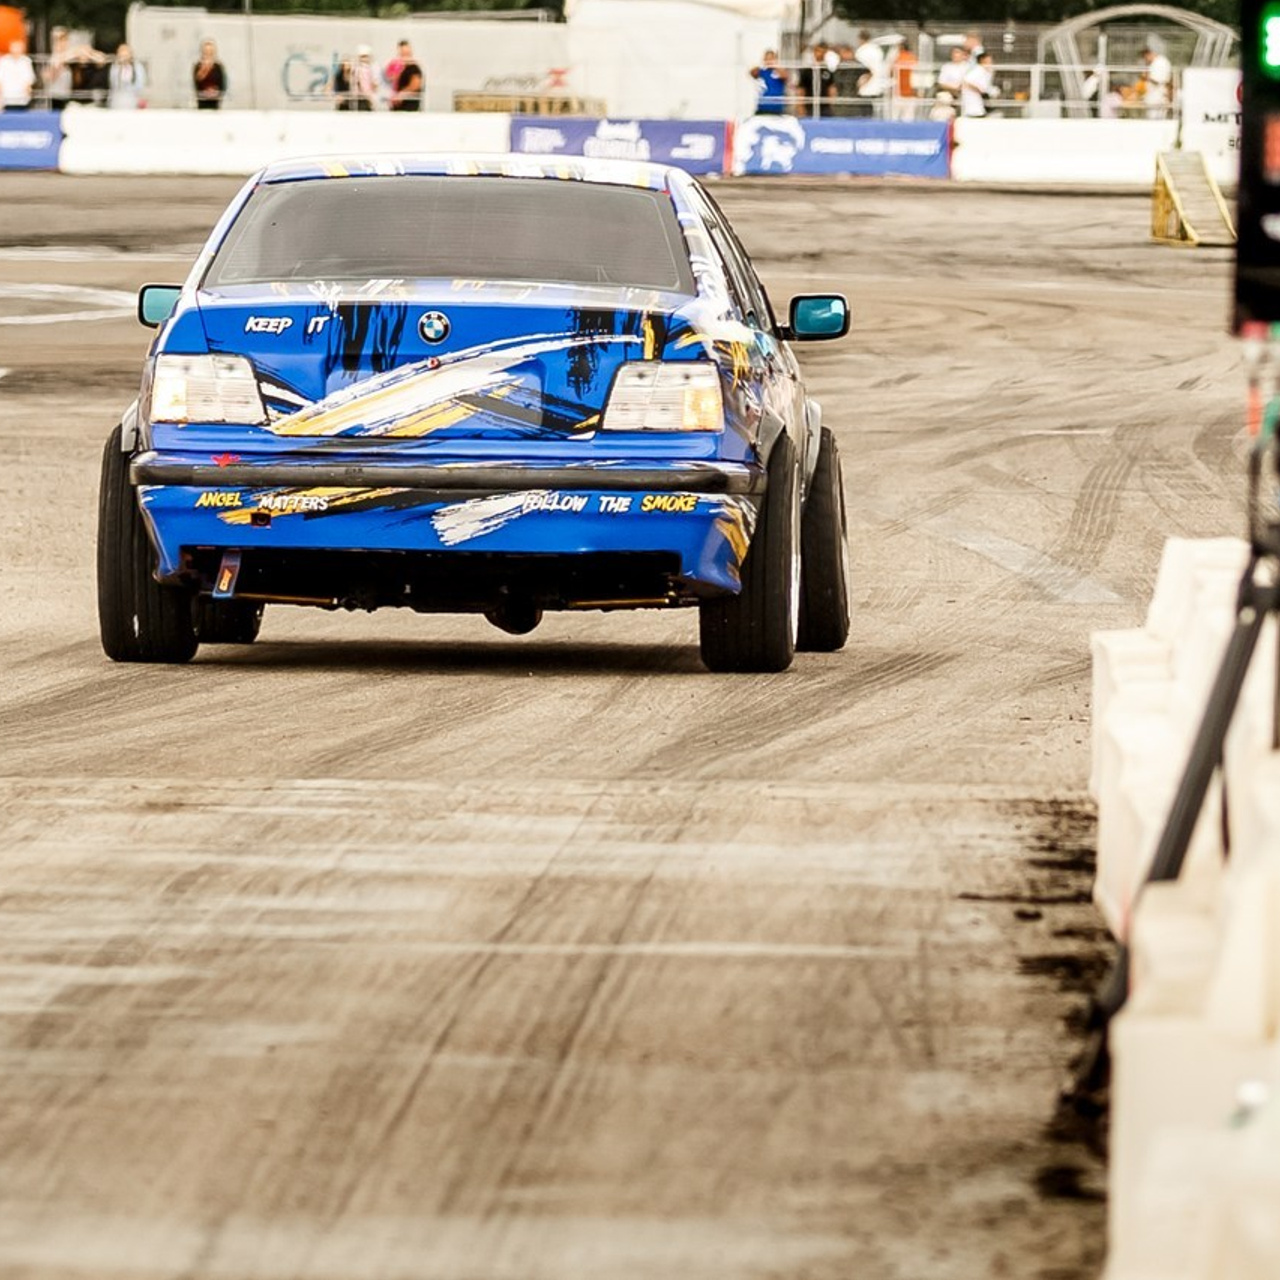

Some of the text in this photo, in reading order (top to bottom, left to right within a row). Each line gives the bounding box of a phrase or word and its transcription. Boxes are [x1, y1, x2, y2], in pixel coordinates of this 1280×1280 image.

[245, 316, 330, 334] KEEP IT
[195, 492, 329, 511] ANGEL MATTERS
[522, 494, 698, 513] FOLLOW THE SMOKE
